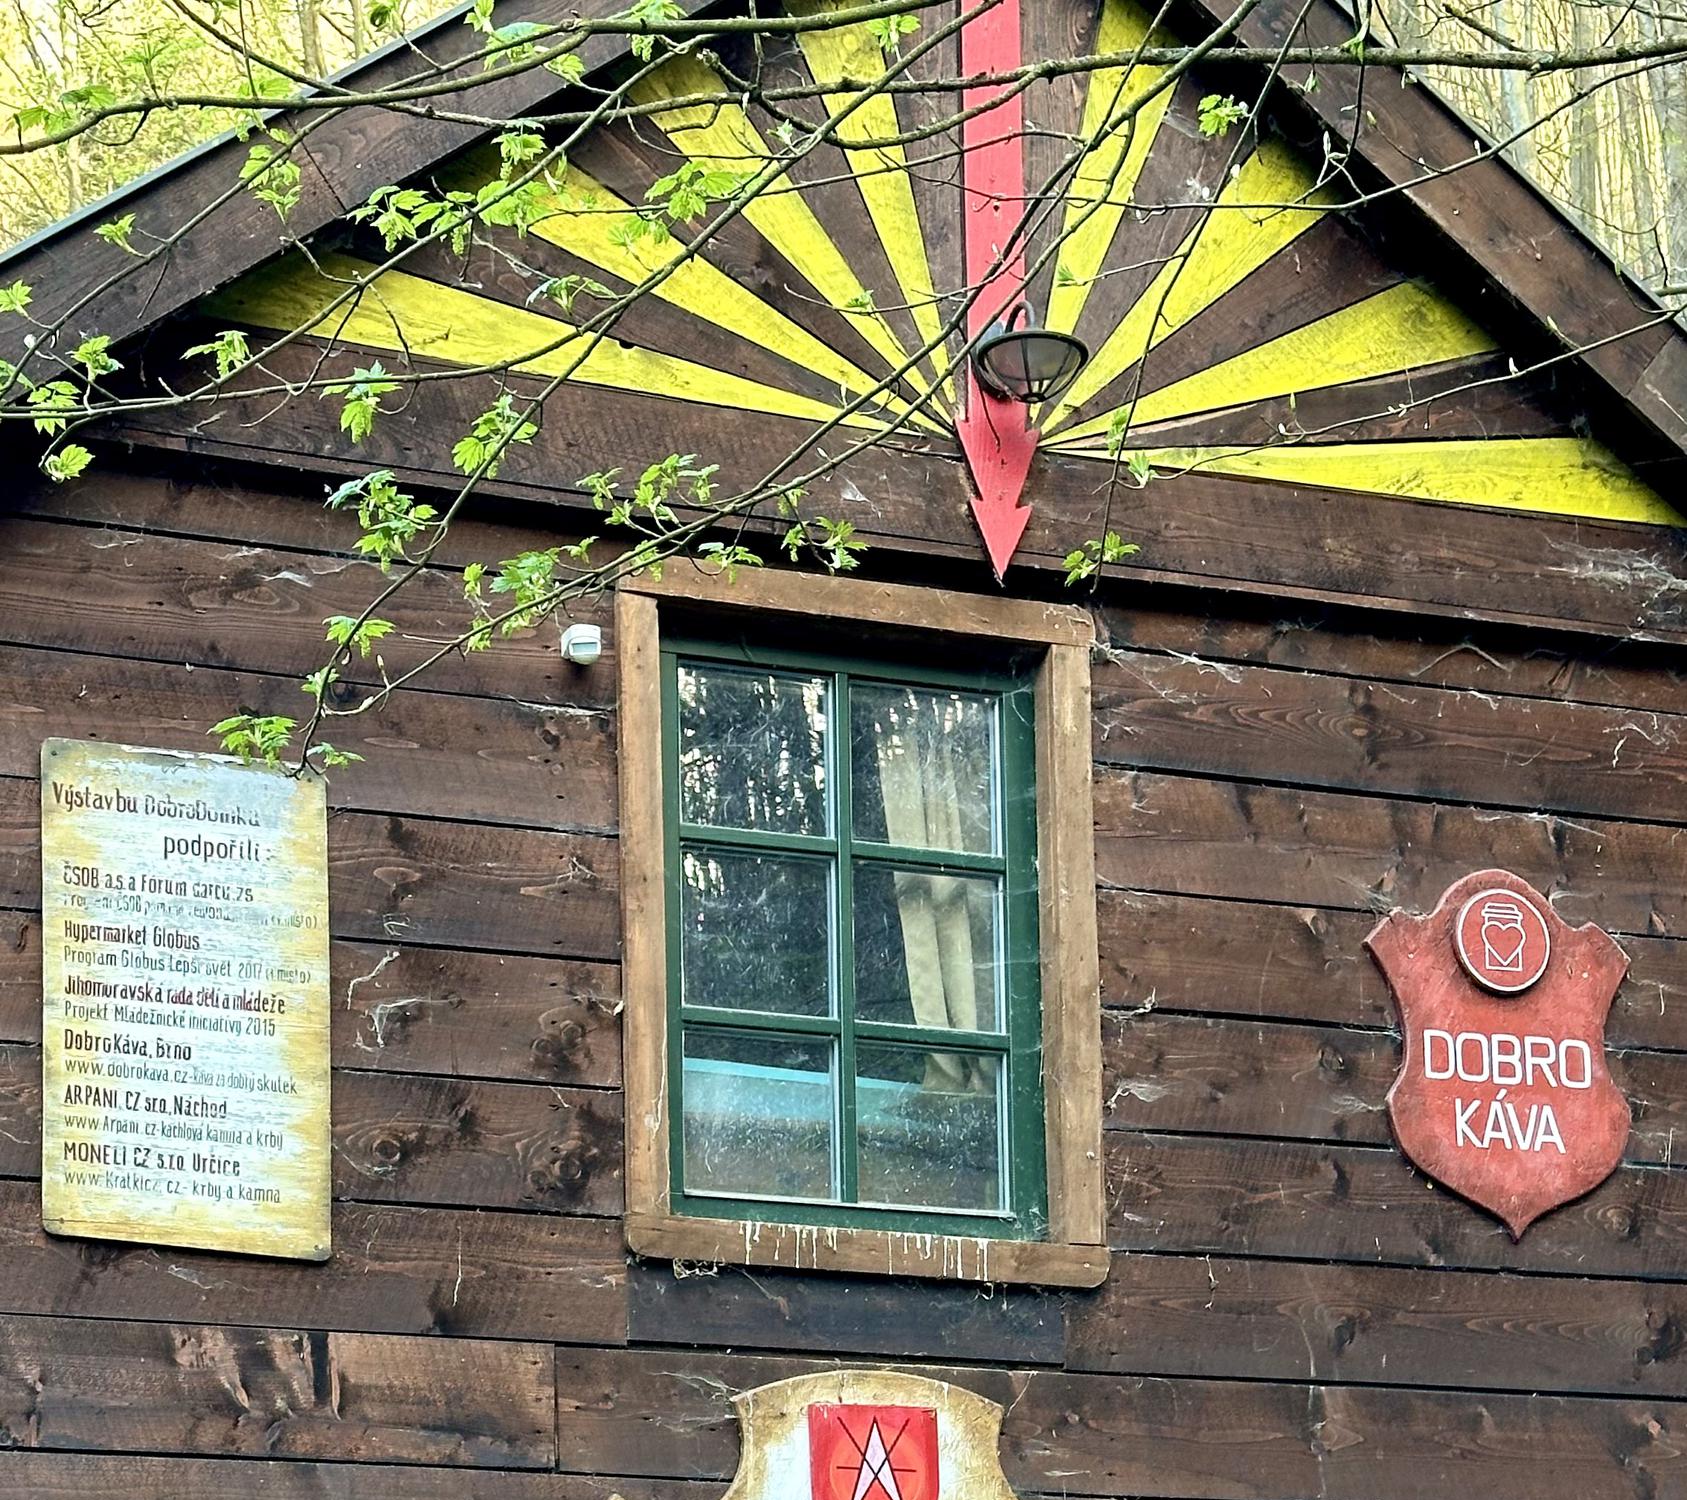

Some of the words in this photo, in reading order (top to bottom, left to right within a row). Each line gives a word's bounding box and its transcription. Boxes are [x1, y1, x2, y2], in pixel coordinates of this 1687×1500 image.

[52, 781, 138, 813] Výstavbu
[64, 920, 147, 946] Hypermarket
[153, 925, 200, 950] Globus
[64, 945, 117, 967] Program
[121, 949, 165, 972] Globus
[222, 994, 230, 1009] a
[64, 1000, 108, 1023] Projekt
[245, 1016, 276, 1037] 2015
[1423, 1028, 1592, 1089] DOBRO
[257, 1074, 298, 1095] skutek
[125, 1091, 141, 1112] CZ
[1455, 1088, 1566, 1154] KÁVA
[246, 1131, 253, 1146] a
[256, 1128, 283, 1151] krby
[63, 1141, 127, 1167] MONELI
[133, 1146, 151, 1169] CZ
[192, 1152, 240, 1177] Určice
[192, 1180, 221, 1202] krby
[226, 1186, 234, 1200] a
[238, 1184, 281, 1204] kamna
